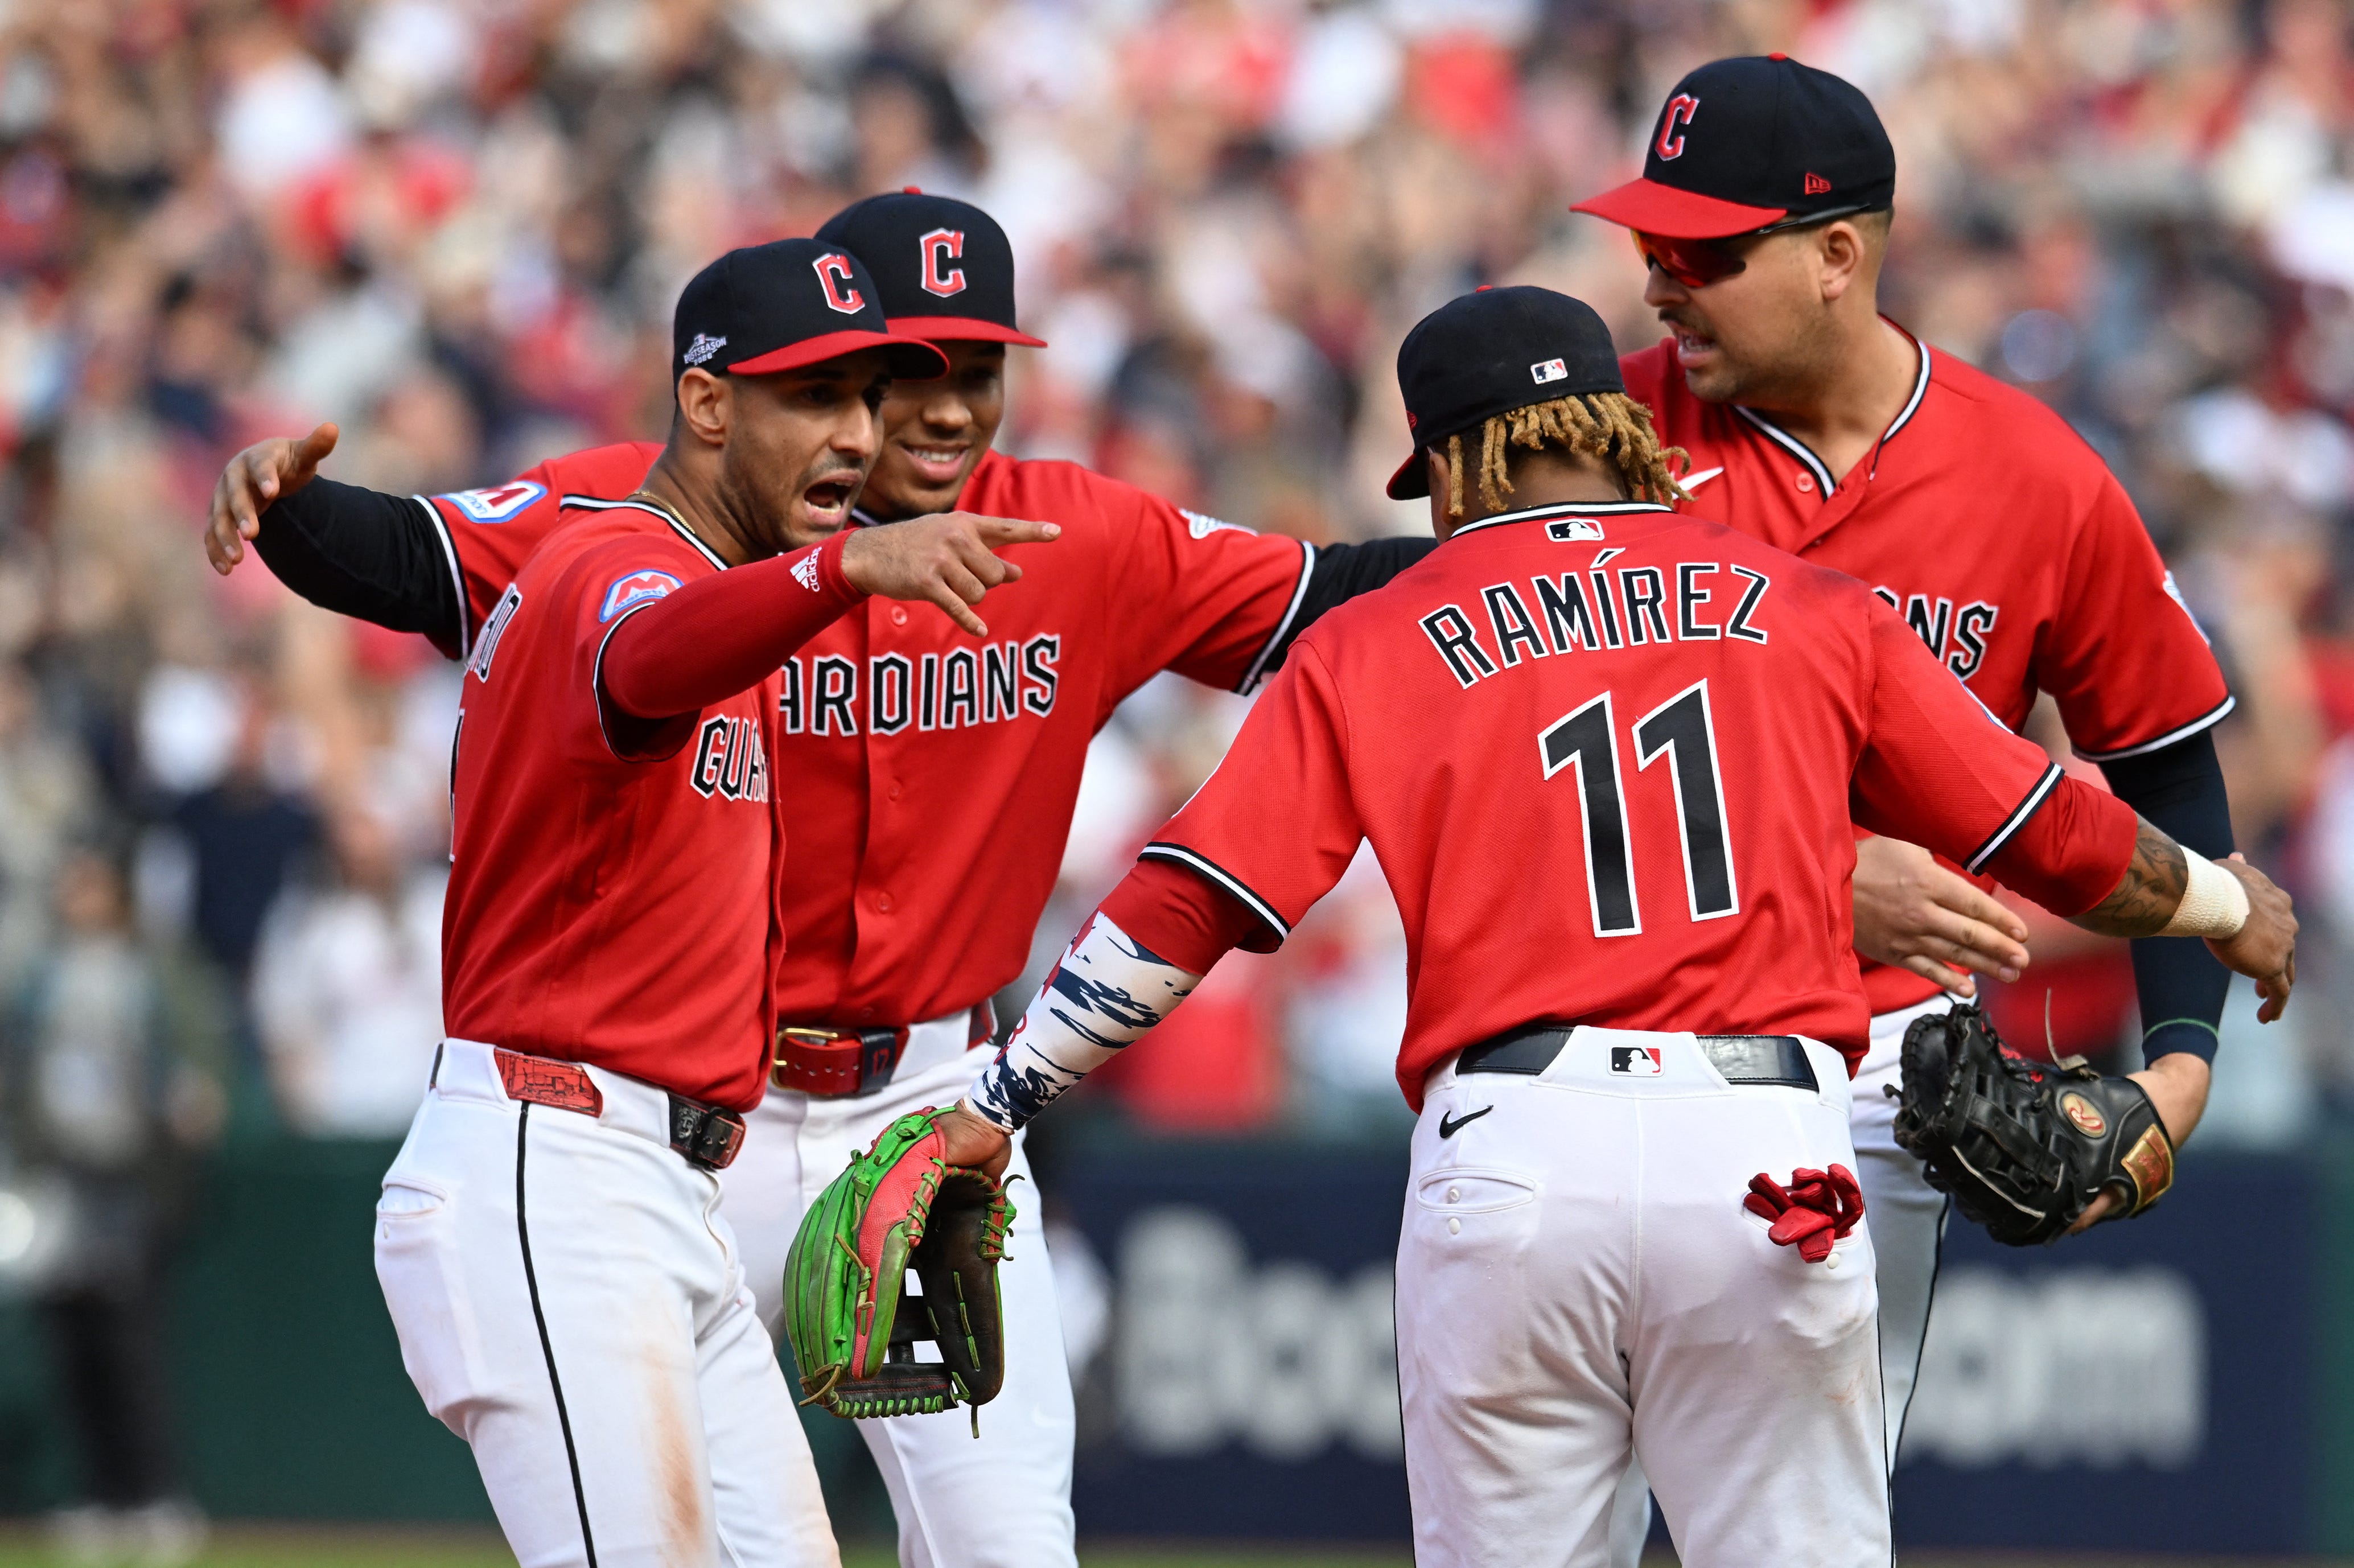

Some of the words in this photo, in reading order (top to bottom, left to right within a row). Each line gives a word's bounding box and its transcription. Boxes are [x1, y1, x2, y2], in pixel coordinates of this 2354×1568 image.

[1655, 92, 1700, 161] C
[813, 253, 865, 315] C
[920, 228, 966, 298] C
[684, 337, 727, 364] POSTSEASON
[806, 546, 822, 592] adidas
[1418, 548, 1770, 690] RAMÍREZ
[1871, 586, 1999, 682] NS
[780, 632, 1060, 736] ARDIANS
[1537, 678, 1739, 938] 11
[872, 1048, 890, 1077] 17
